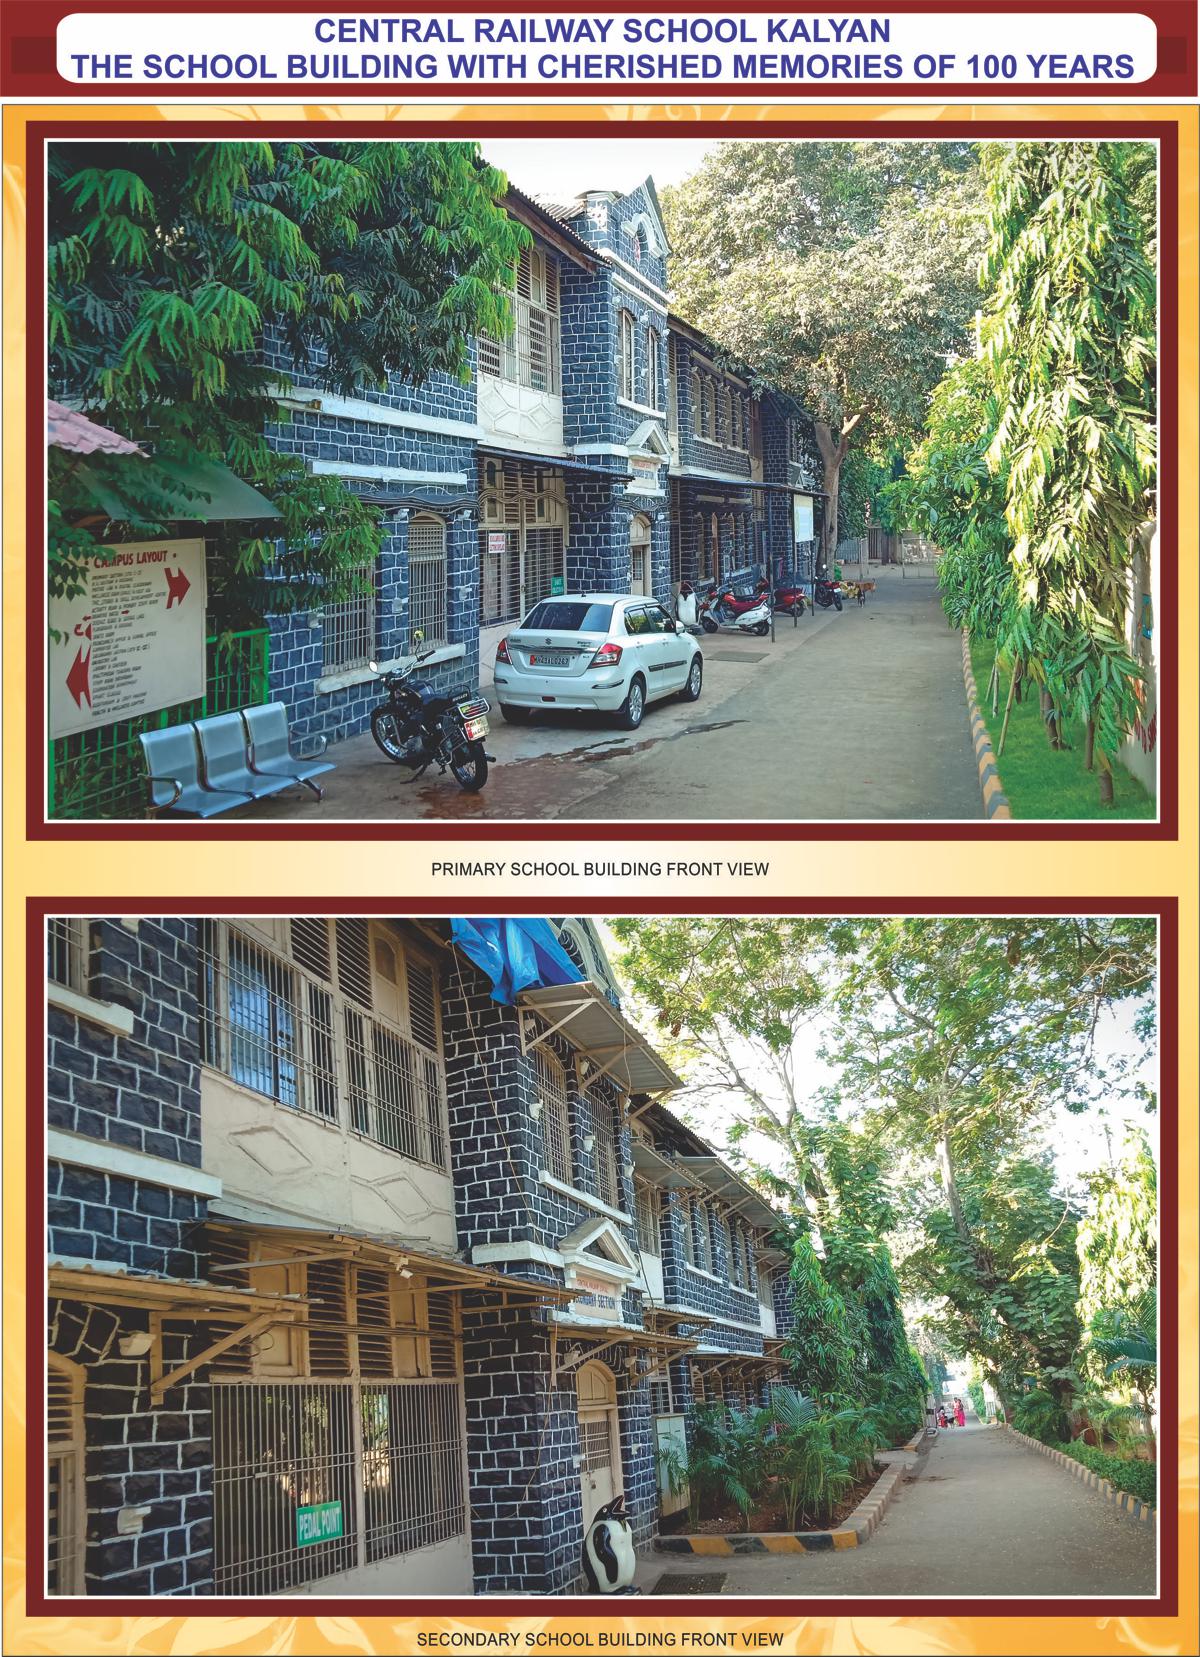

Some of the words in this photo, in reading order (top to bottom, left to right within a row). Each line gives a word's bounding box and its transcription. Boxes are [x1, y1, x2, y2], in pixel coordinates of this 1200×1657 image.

[137, 550, 168, 565] LAYOUT
[299, 1512, 321, 1541] PEDAL
[322, 1507, 340, 1536] POINT
